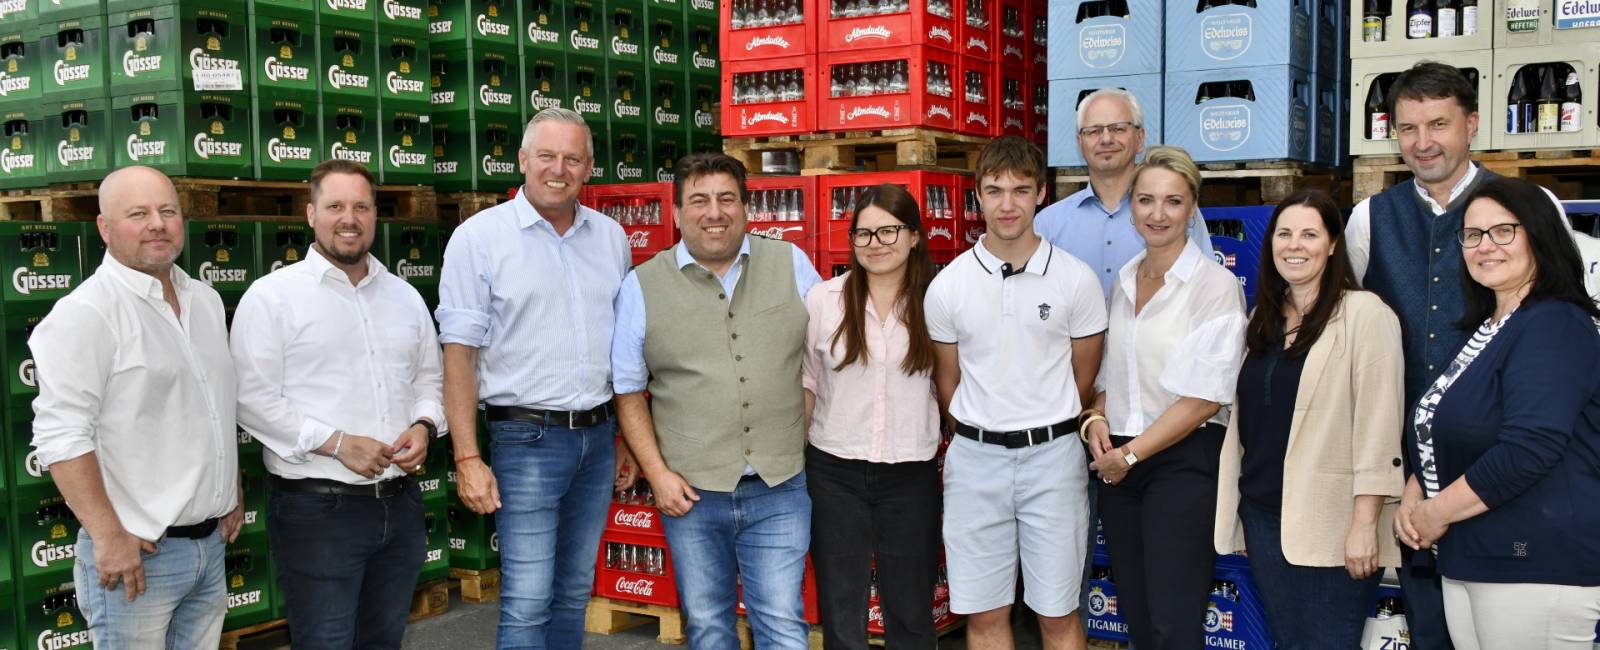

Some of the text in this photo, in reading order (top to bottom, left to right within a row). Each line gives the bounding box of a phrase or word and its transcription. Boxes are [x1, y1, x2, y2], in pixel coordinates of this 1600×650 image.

[384, 0, 421, 20] Gösser
[428, 19, 452, 33] sser
[477, 13, 510, 36] Gösser
[528, 22, 559, 44] Gösser
[1409, 19, 1431, 27] Zipfer
[571, 29, 599, 50] Gösser
[746, 35, 790, 50] Almdudler
[845, 25, 891, 43] Almdudler
[612, 35, 638, 56] Gösser
[653, 46, 677, 64] Gösser
[123, 50, 161, 77] Gösser
[190, 48, 239, 71] Gösser
[264, 56, 309, 81] Gösser
[693, 51, 716, 69] Gösser
[54, 60, 90, 86] Gösser
[328, 65, 369, 89] Gösser
[387, 71, 424, 94] Gösser
[431, 90, 455, 104] sser
[480, 84, 512, 106] Gösser
[531, 90, 561, 110] Gösser
[574, 95, 602, 115] Gösser
[615, 98, 640, 118] Gösser
[655, 106, 679, 125] Gösser
[748, 112, 789, 125] Almdudler
[848, 105, 890, 120] Almdudler
[695, 110, 712, 128] Göss
[58, 140, 94, 166] Gösser
[127, 133, 166, 161] Gösser
[194, 132, 242, 159] Gösser
[268, 138, 312, 162] Gösser
[331, 142, 371, 163] Gösser
[1, 148, 34, 173] Gösser
[390, 145, 426, 168] Gösser
[433, 160, 458, 174] sser
[483, 155, 514, 176] Gösser
[617, 162, 642, 180] Gösser
[657, 167, 674, 183] Göss
[13, 266, 72, 294] Gösser
[199, 261, 247, 286] Gösser
[397, 259, 433, 280] Gösser
[419, 478, 440, 492] sser
[615, 509, 653, 529] Coca-Cola
[31, 540, 76, 567] Göss
[616, 576, 654, 596] Coca-Cola
[226, 589, 261, 609] össer
